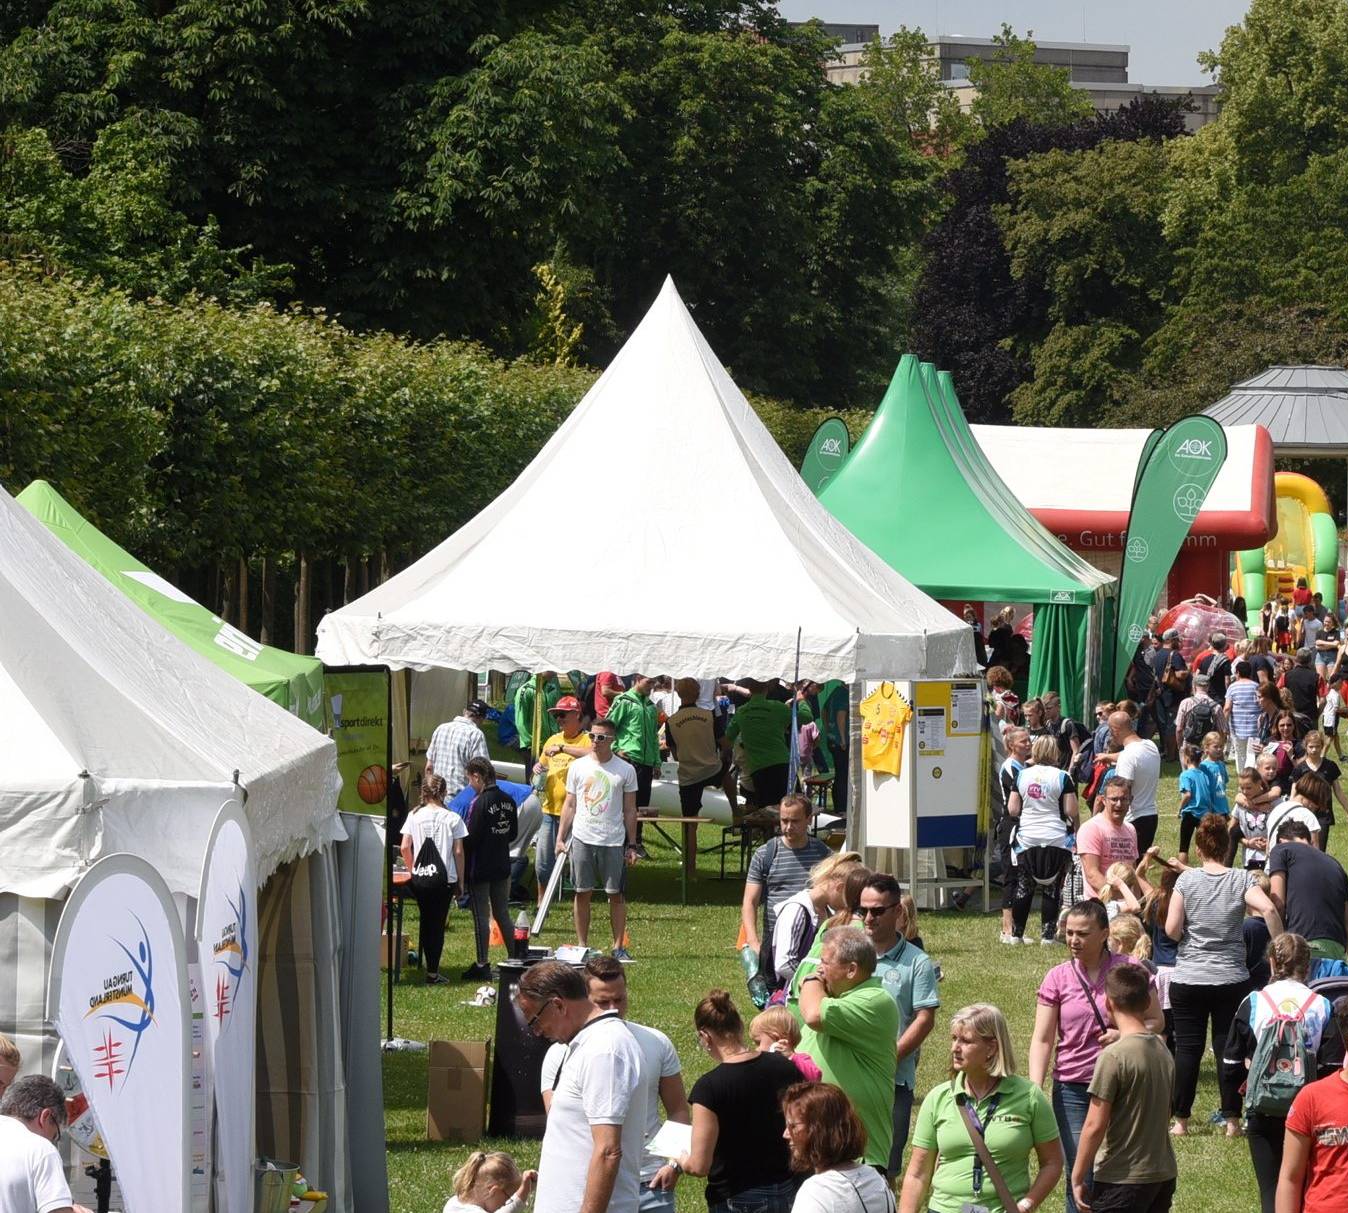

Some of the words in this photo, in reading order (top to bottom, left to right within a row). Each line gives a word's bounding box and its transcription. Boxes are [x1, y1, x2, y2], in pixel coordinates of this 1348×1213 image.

[820, 438, 841, 453] AOK
[1175, 439, 1212, 456] AOK
[1079, 530, 1114, 547] Gut
[1185, 535, 1217, 547] mm
[412, 862, 438, 877] Jeep
